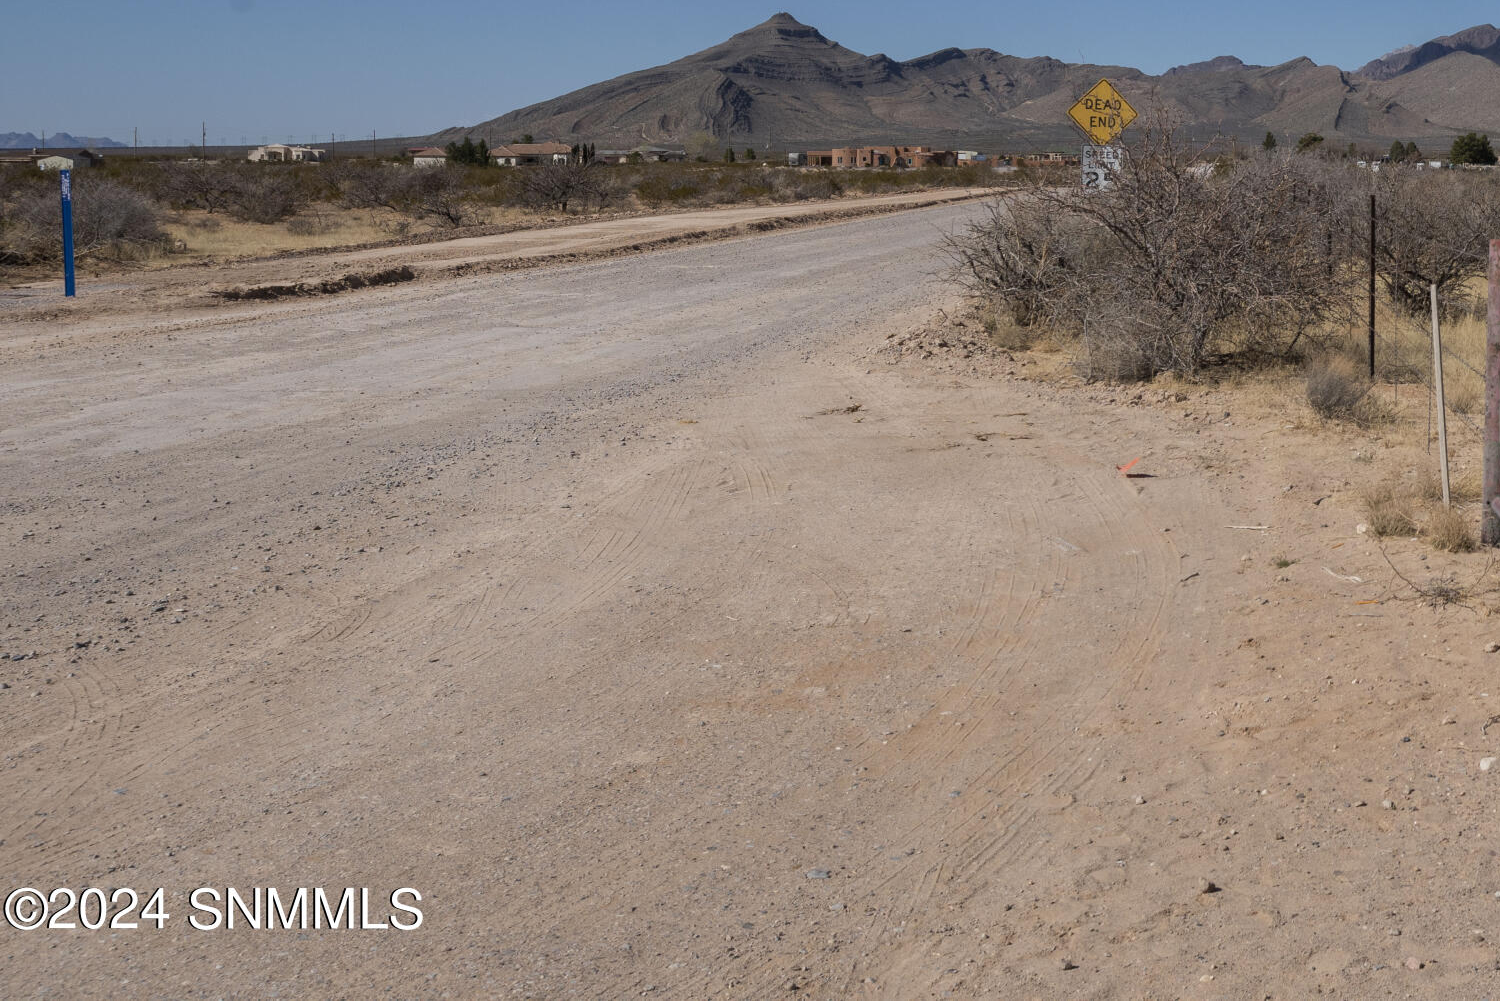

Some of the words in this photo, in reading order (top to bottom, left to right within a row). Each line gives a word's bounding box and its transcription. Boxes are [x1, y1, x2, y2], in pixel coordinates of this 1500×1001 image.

[1085, 98, 1122, 110] DEAD
[1090, 116, 1116, 127] END
[1088, 160, 1116, 169] LIMT
